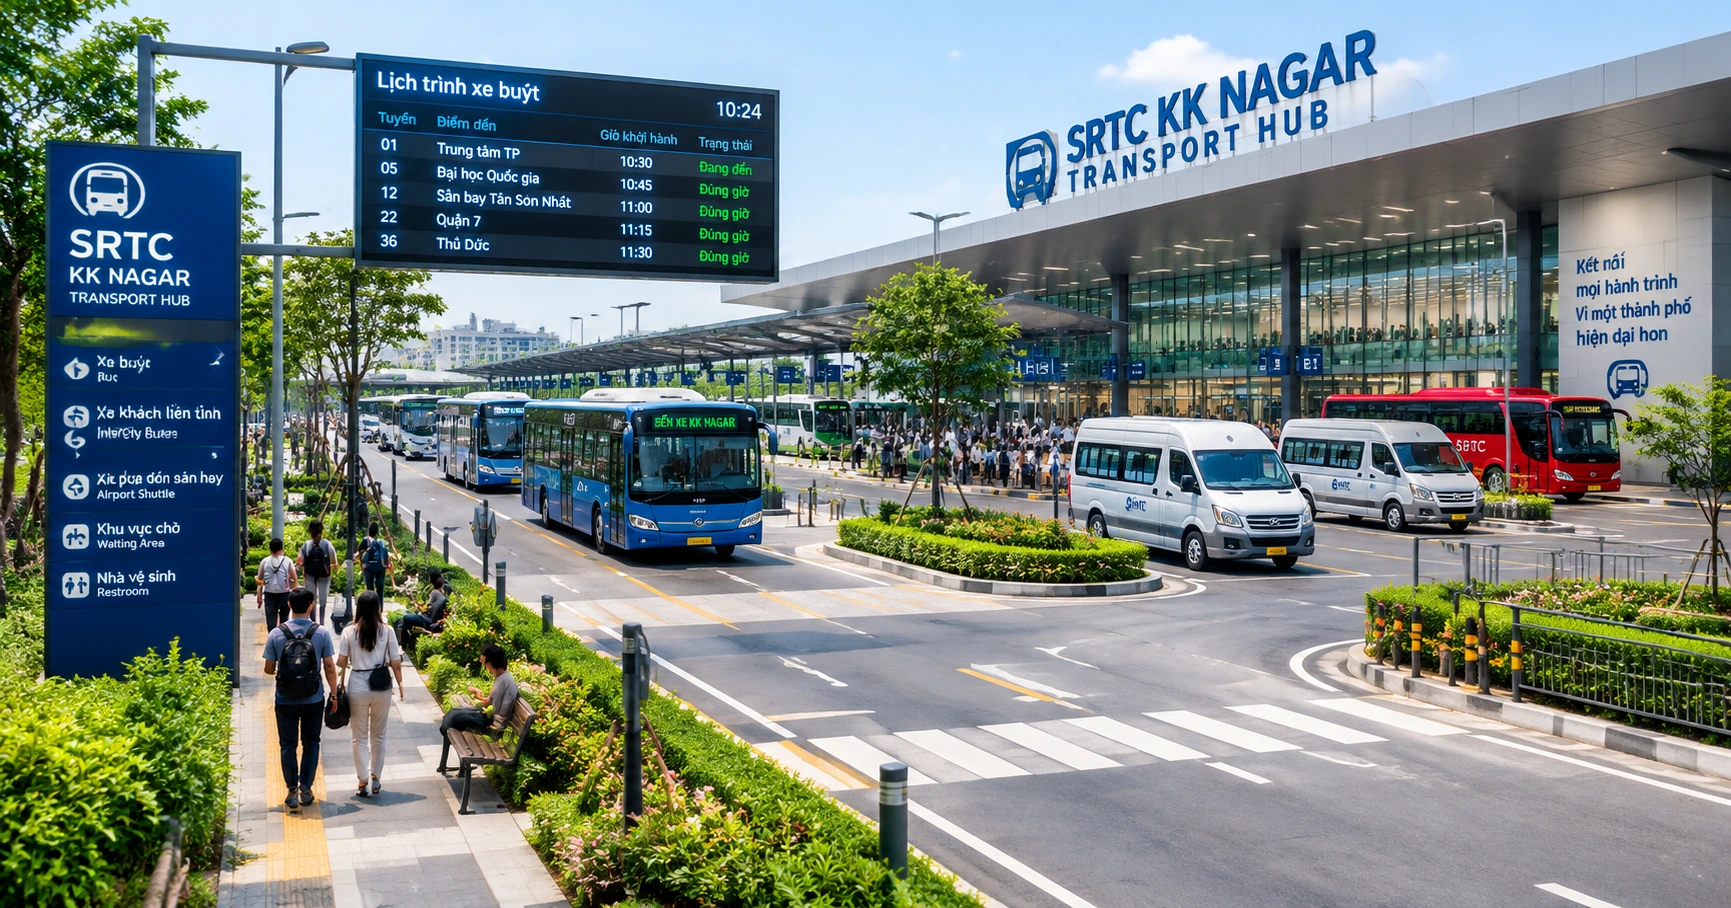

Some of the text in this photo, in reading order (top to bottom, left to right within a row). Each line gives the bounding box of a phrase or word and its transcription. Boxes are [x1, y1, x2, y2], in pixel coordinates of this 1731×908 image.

[377, 71, 540, 104] Lịch trình xe buýt
[1067, 29, 1378, 163] SRTC KK NAGAR
[717, 101, 762, 120] 10:24
[381, 138, 397, 151] 01
[437, 142, 474, 159] Trung
[504, 147, 520, 159] TP
[698, 136, 729, 152] Trạng
[1066, 99, 1329, 193] TRANSPORT HUB
[381, 162, 398, 175] 05
[620, 156, 653, 169] 10:30
[699, 161, 729, 177] Đang
[461, 167, 483, 183] học
[521, 173, 540, 186] gia
[620, 179, 653, 191] 10:45
[381, 186, 398, 199] 12
[464, 191, 486, 206] bay
[620, 201, 653, 214] 11:00
[380, 210, 398, 224] 22
[473, 215, 482, 227] 7
[620, 224, 653, 236] 11:15
[69, 229, 174, 262] SRTC
[380, 234, 398, 248] 36
[620, 246, 653, 259] 11:30
[69, 266, 191, 287] KK NAGAR
[1576, 280, 1601, 300] mọi
[69, 292, 191, 307] TRANSPORT HUB
[1664, 296, 1693, 319] phố
[1576, 328, 1609, 349] hiện
[689, 417, 702, 429] KK
[97, 522, 125, 536] Khu
[148, 569, 177, 583] sinh
[97, 586, 150, 598] Restroom
